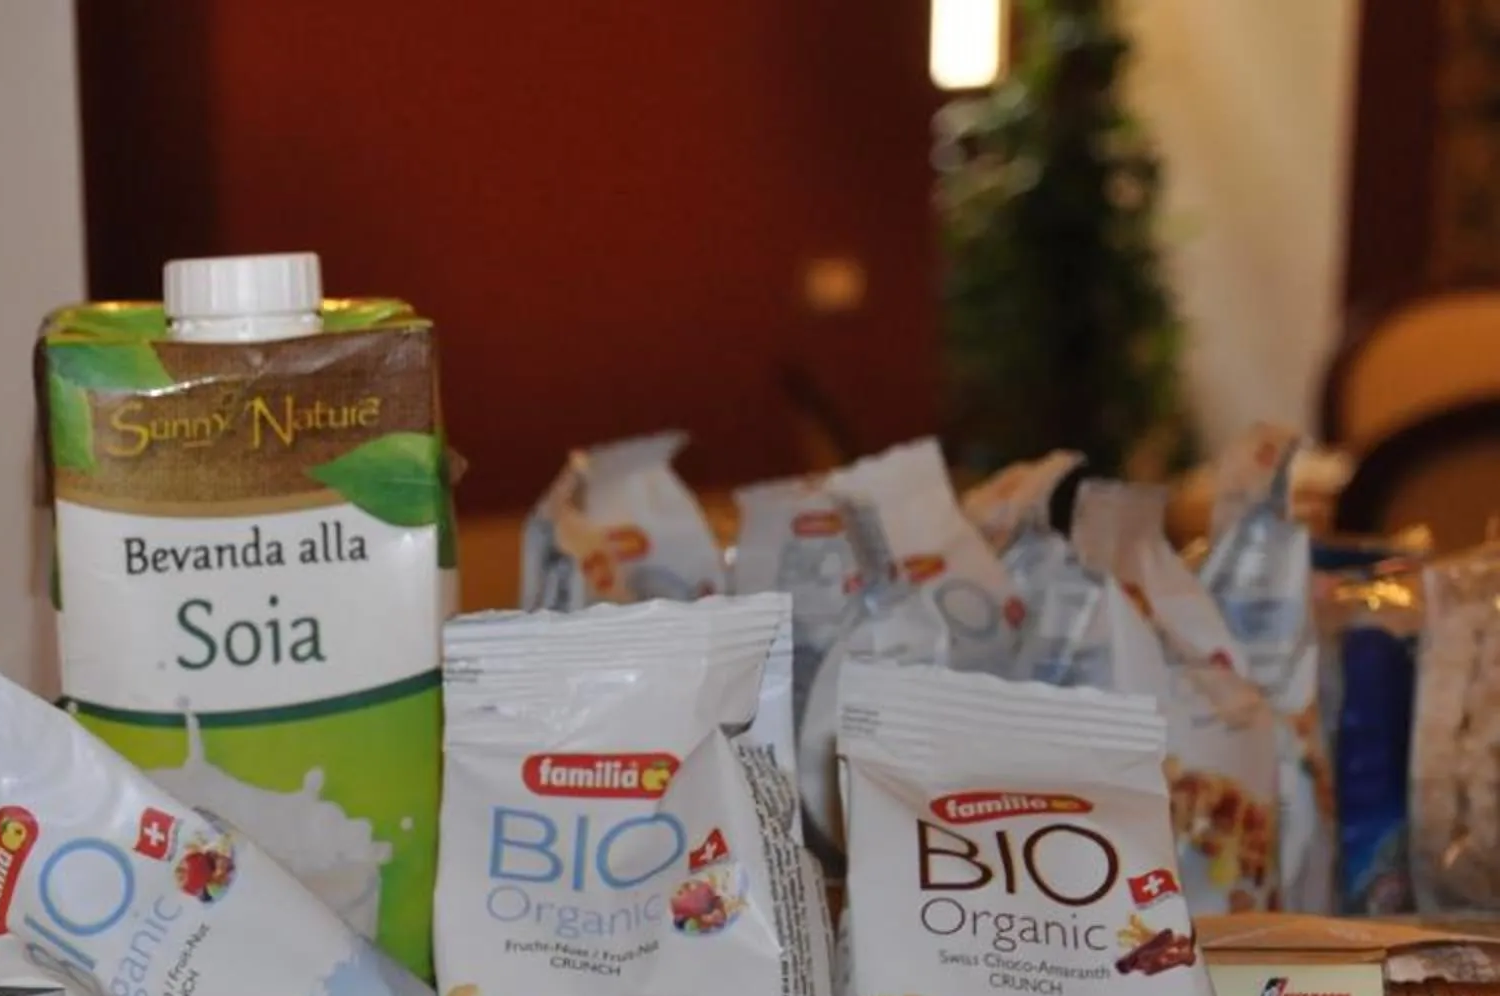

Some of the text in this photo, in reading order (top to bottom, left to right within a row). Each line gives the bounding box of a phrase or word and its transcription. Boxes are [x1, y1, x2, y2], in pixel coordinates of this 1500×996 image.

[107, 394, 381, 457] Sunny Nature
[124, 521, 369, 576] Bevanda alla
[176, 594, 326, 671] Soia
[539, 757, 639, 789] familia
[945, 794, 1048, 819] familia
[489, 806, 687, 892] BIO
[917, 818, 1119, 907] BIO
[486, 885, 664, 939] Organic
[921, 897, 1109, 953] Organic
[549, 955, 622, 976] CRUNCH
[988, 973, 1063, 996] CRUNCH
